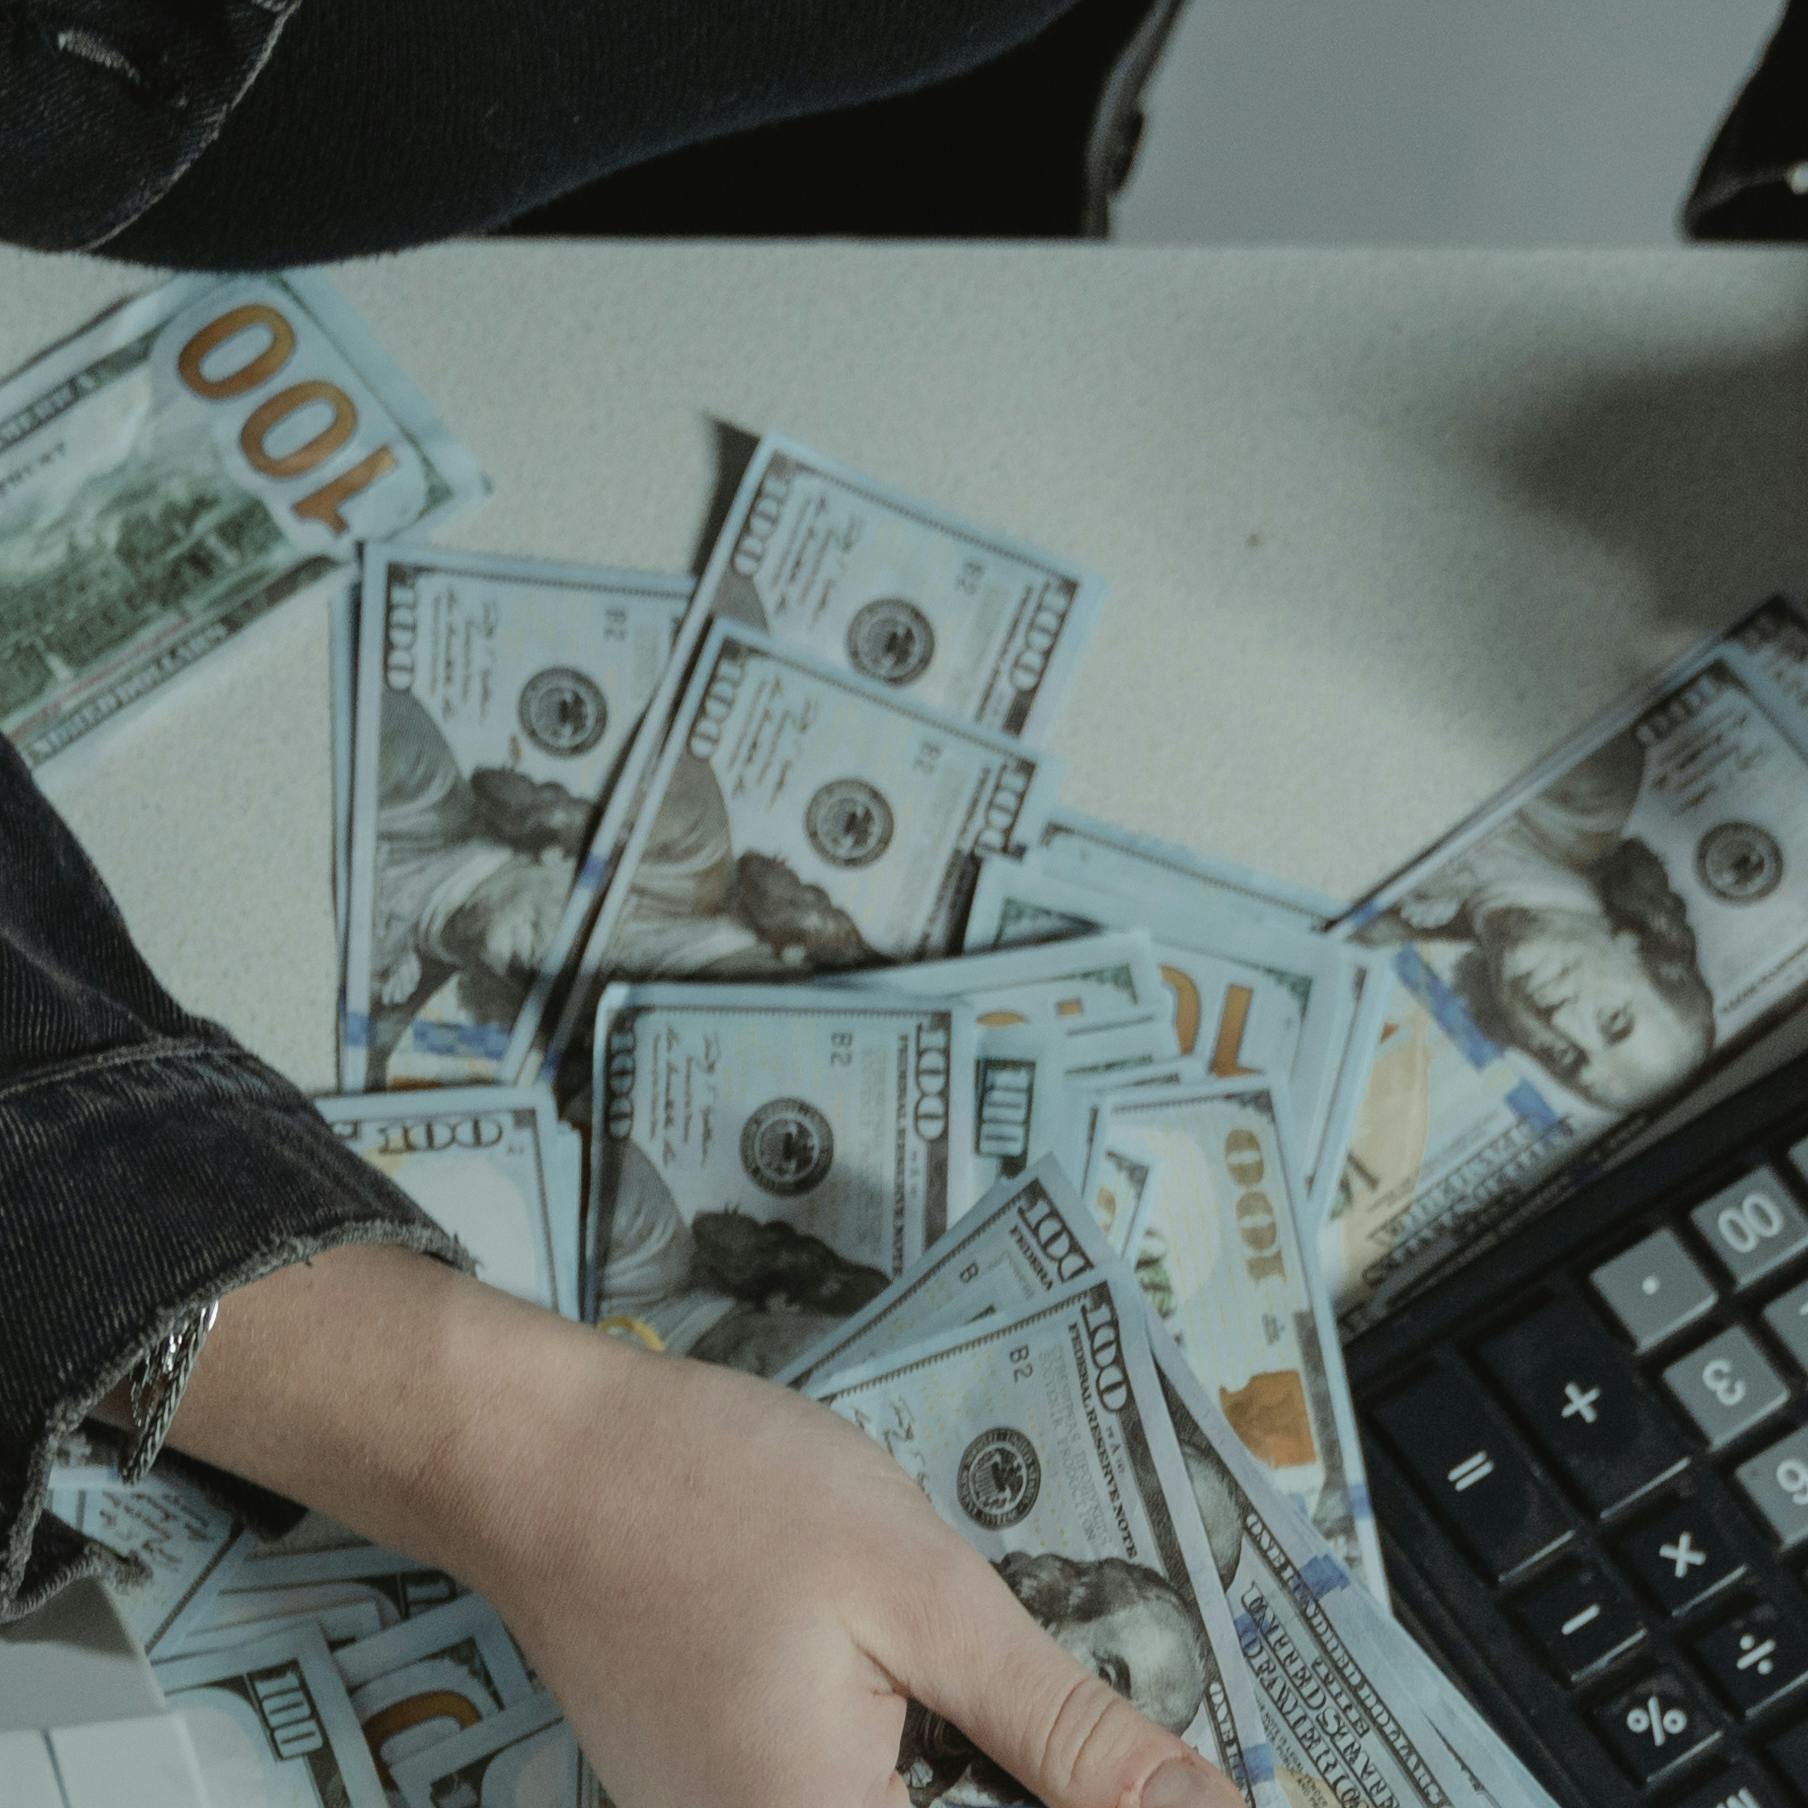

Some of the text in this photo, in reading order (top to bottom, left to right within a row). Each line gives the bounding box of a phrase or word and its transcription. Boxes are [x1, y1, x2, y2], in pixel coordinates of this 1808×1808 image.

[179, 304, 399, 534] 100
[729, 478, 793, 578] 100
[383, 590, 417, 686] 100
[1007, 587, 1073, 693] 100
[689, 652, 745, 760] 100
[975, 762, 1027, 857] 100
[829, 1030, 853, 1068] B2
[906, 1024, 945, 1143] 100
[1224, 1128, 1286, 1284] 100
[1718, 1194, 1784, 1254] 00
[1005, 1344, 1039, 1383] B2
[1077, 1295, 1142, 1412] 100
[1703, 1359, 1745, 1407] 3
[1064, 1319, 1138, 1556] FEDERAL RESERVE NOTE
[1234, 1585, 1333, 1716] UNITED
[1238, 1510, 1448, 1807] ONE HUNDRED DOLLARS
[249, 1666, 326, 1764] 100
